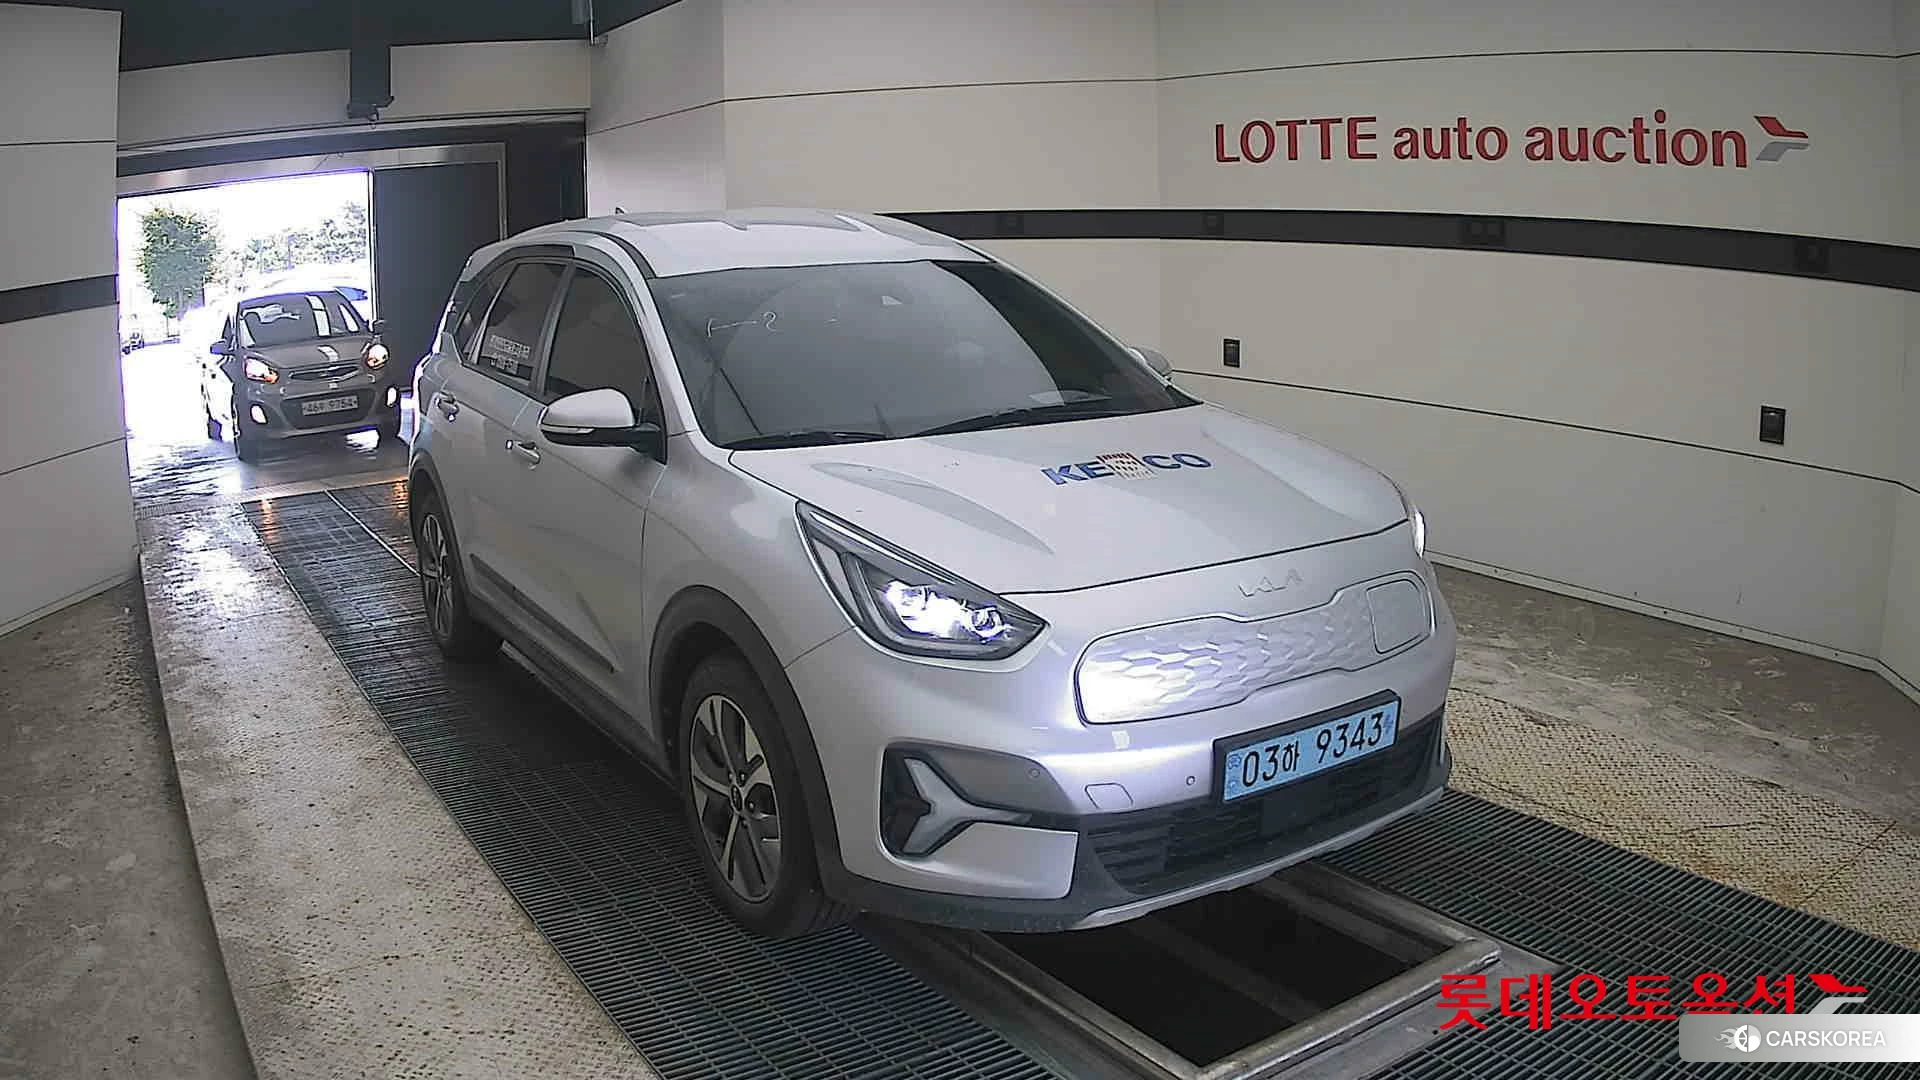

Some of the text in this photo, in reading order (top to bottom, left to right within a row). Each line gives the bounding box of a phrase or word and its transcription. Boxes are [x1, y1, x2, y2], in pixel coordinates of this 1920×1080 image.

[1215, 109, 1748, 169] LOTTE auto auction
[1040, 452, 1212, 486] KECO
[1242, 711, 1384, 787] 03하 9343
